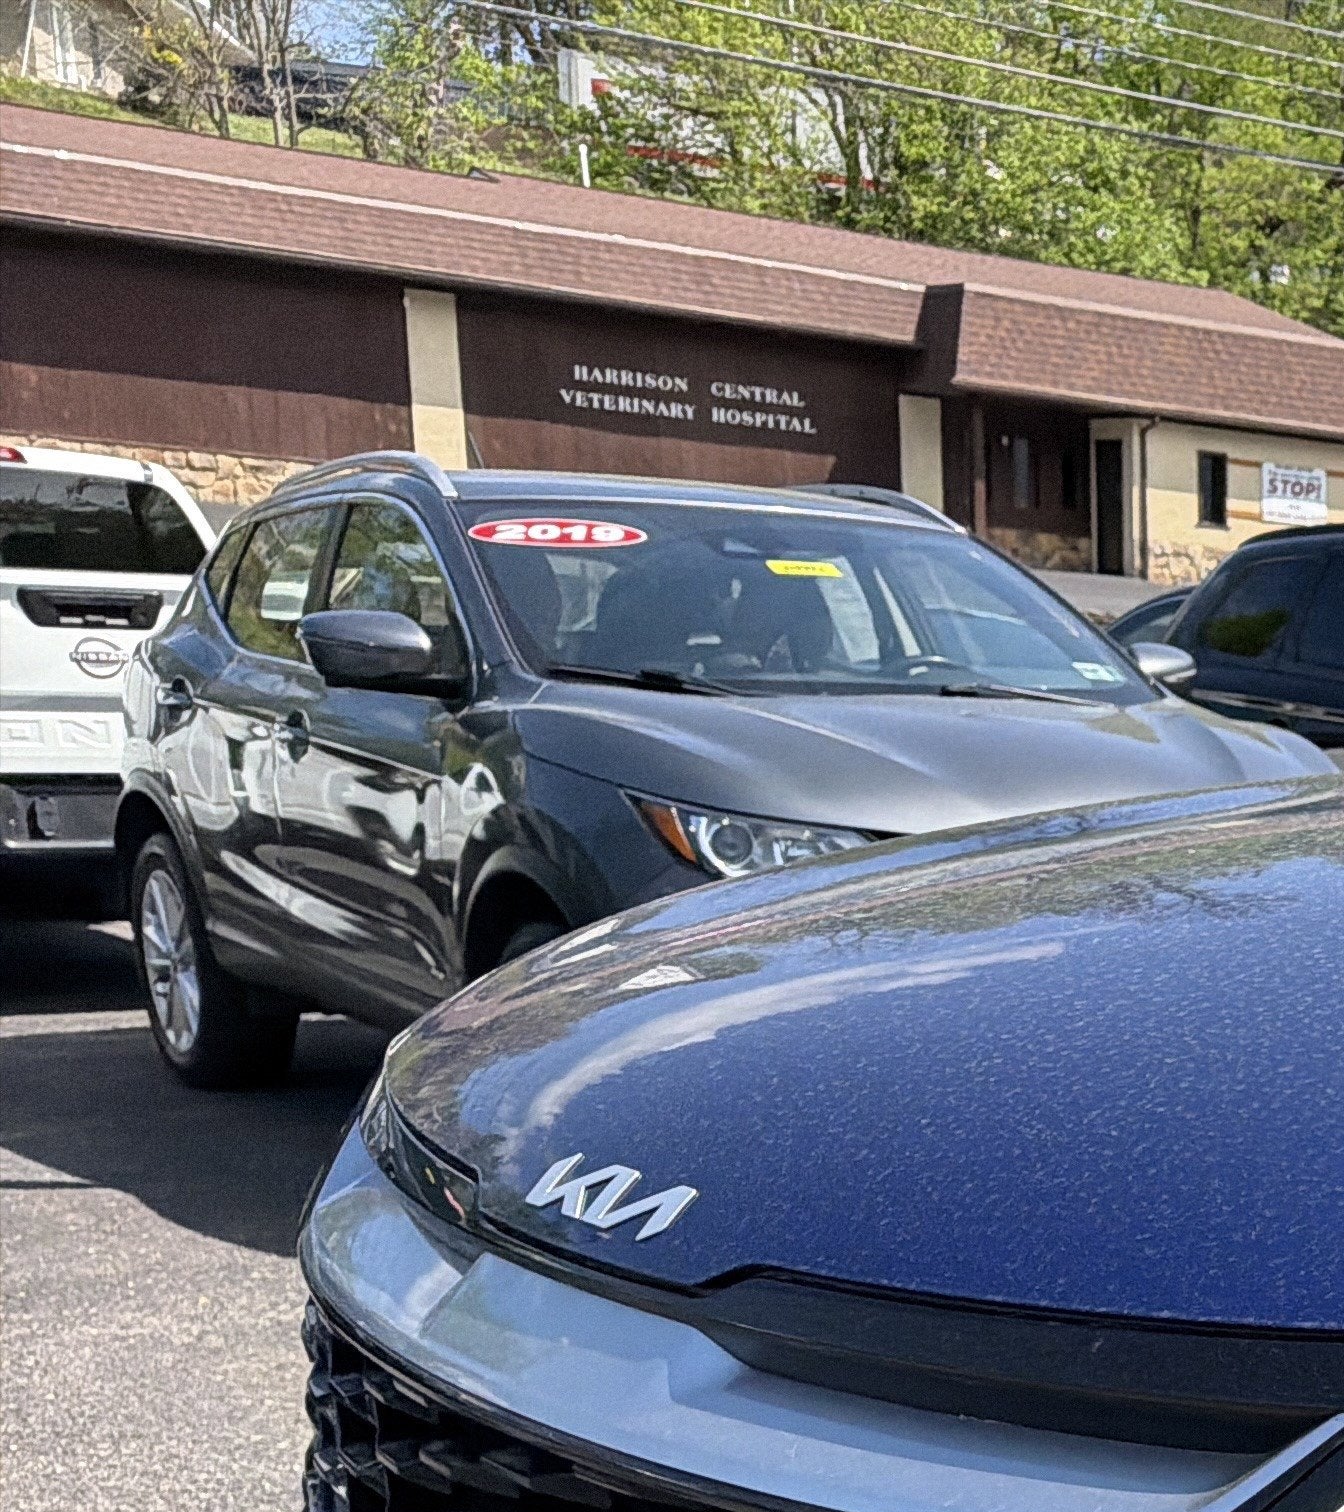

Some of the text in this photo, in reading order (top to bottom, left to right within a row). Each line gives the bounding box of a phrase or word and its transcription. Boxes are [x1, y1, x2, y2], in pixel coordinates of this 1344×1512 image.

[573, 364, 806, 408] HARRISON CENTRAL
[558, 388, 818, 435] VETERINARY HOSPITAL
[494, 524, 626, 542] 2019
[525, 1152, 699, 1242] KIA
